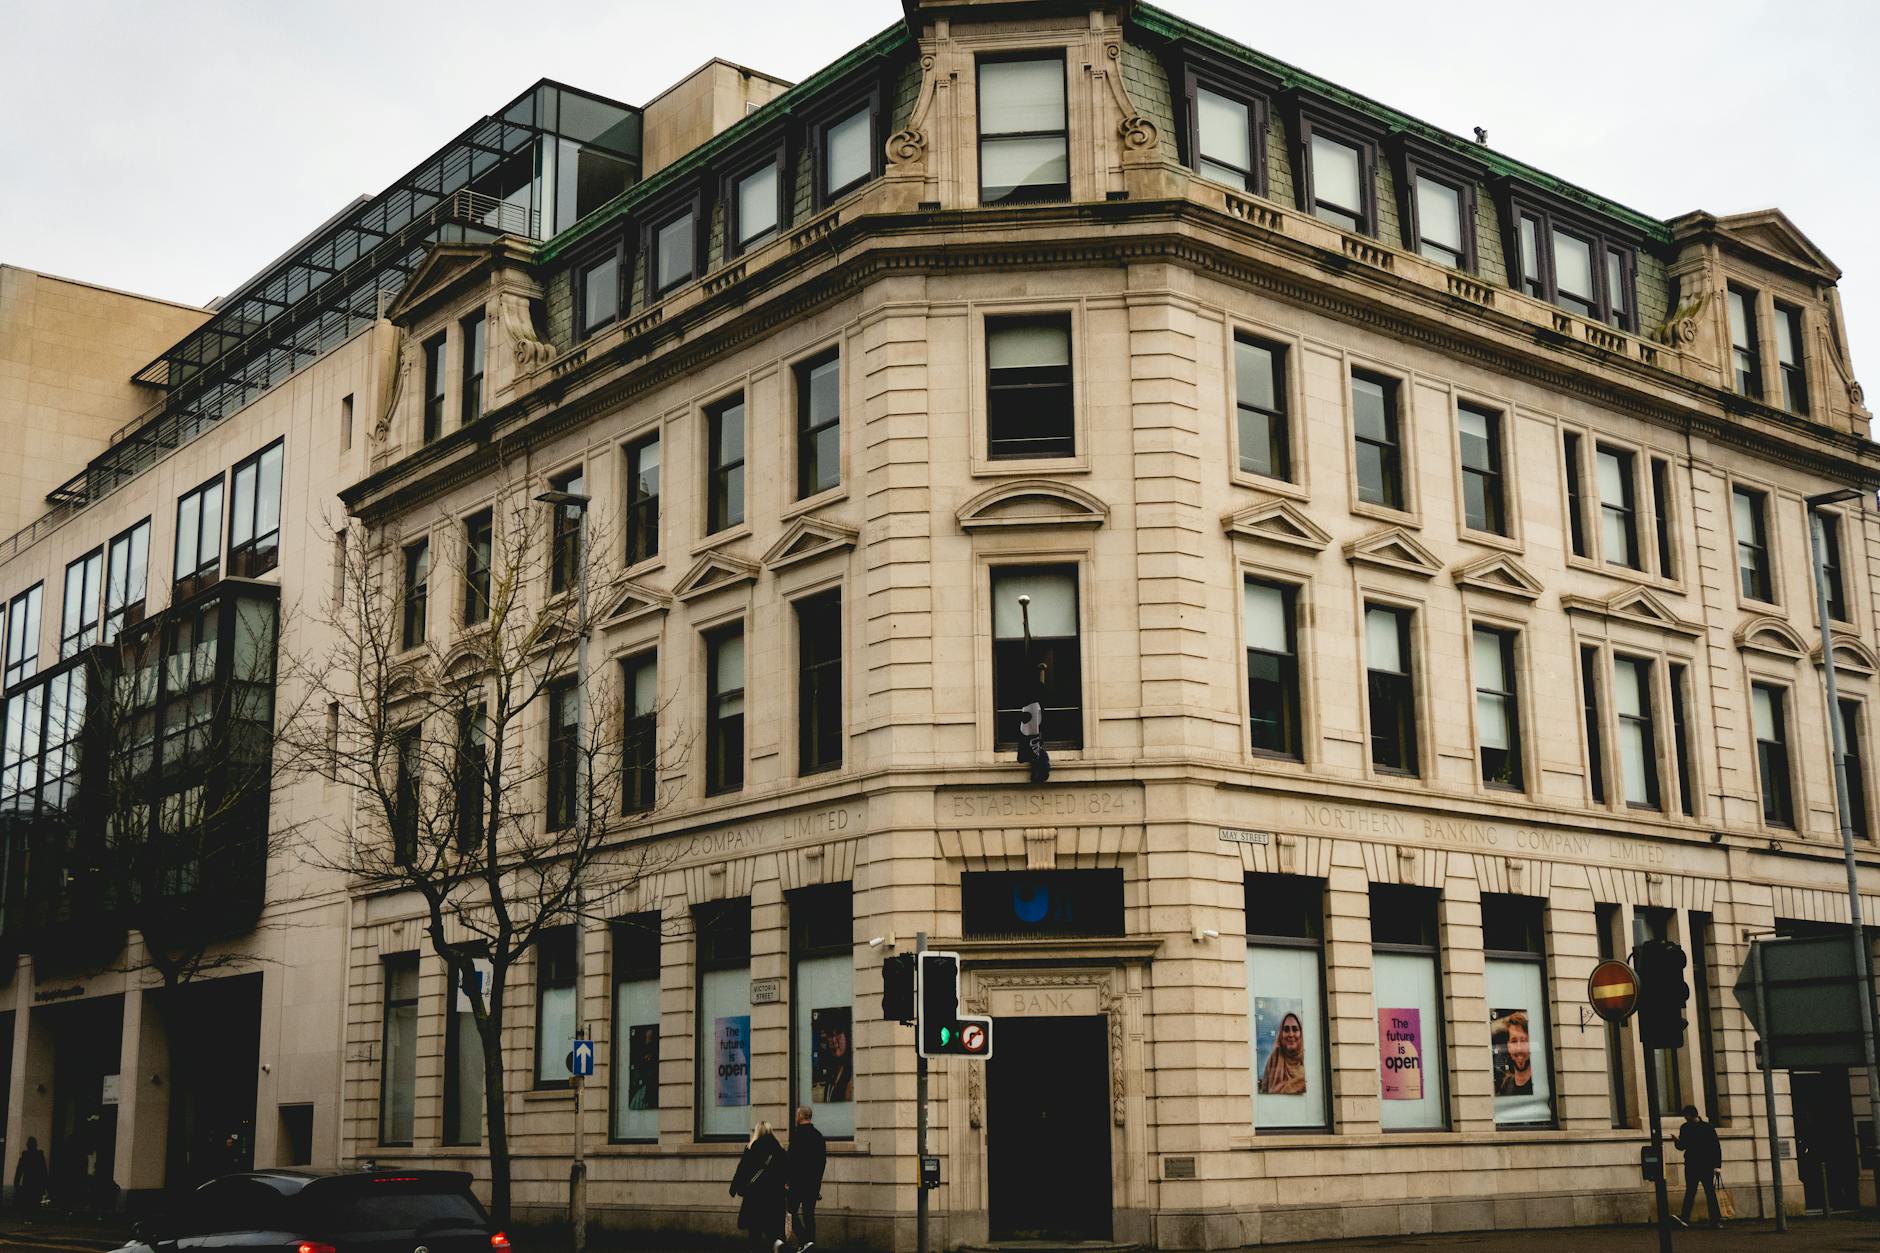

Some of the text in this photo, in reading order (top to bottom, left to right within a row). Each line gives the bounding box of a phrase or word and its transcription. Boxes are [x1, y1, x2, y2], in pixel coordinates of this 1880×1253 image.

[952, 792, 1125, 818] ESTABLISHED 1824
[690, 824, 766, 856] COMPANY
[783, 808, 849, 839] LIMITED
[1221, 830, 1267, 843] MAY STREET
[1303, 804, 1666, 864] NORTHERN BANKING COMPANY LIMITED
[754, 984, 776, 992] VICTORIA
[1014, 992, 1075, 1013] BANK
[1391, 1018, 1409, 1029] The
[725, 1026, 739, 1037] The
[1386, 1030, 1415, 1042] future
[719, 1039, 745, 1050] future
[1397, 1043, 1406, 1055] is
[729, 1053, 735, 1062] is
[1385, 1056, 1420, 1073] open
[718, 1063, 748, 1080] open
